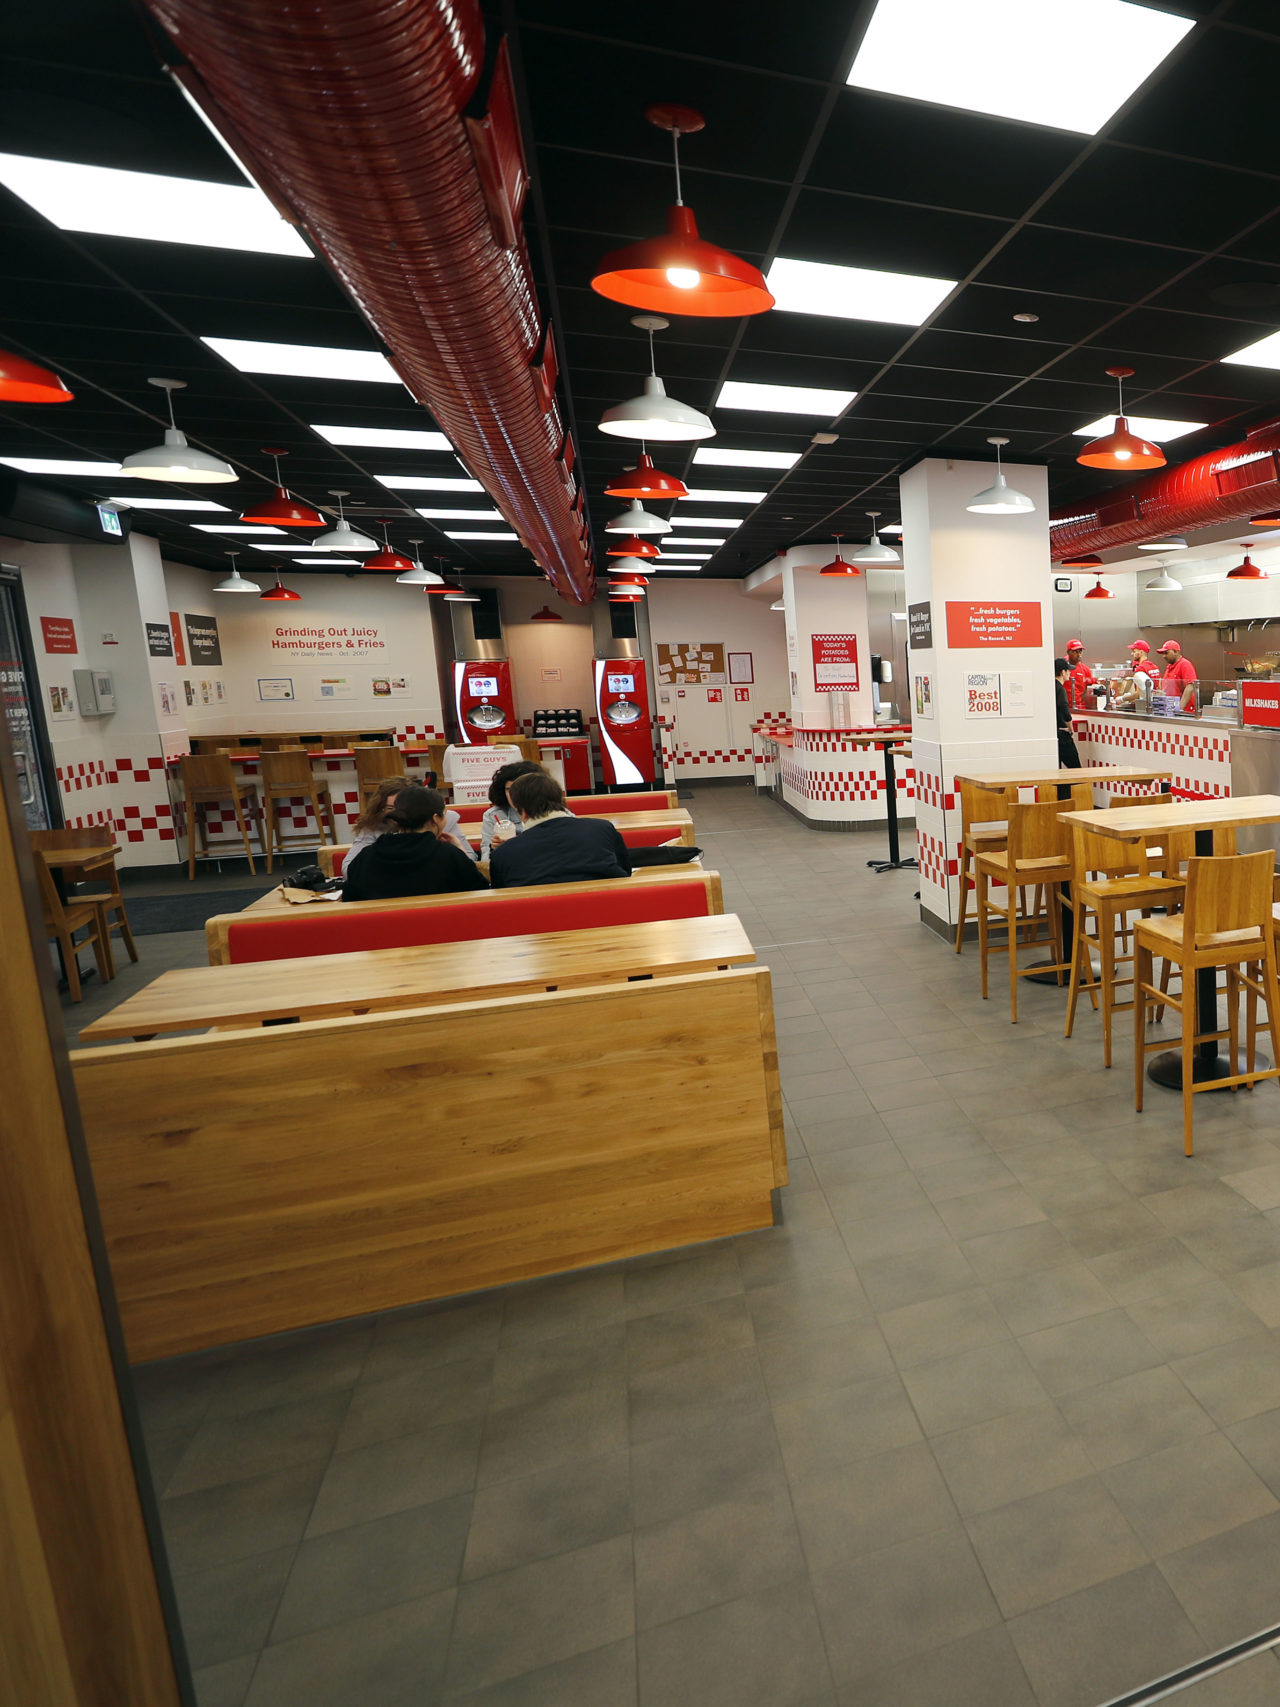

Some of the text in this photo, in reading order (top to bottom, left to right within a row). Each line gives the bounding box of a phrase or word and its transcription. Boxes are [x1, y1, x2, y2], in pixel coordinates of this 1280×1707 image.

[996, 608, 1019, 616] burgers
[275, 628, 378, 638] Grinding Out Juicy
[272, 639, 385, 650] Hamburgers & Fries
[968, 690, 998, 700] Best
[968, 701, 999, 712] 2008
[1245, 698, 1279, 709] MILKSHAKES
